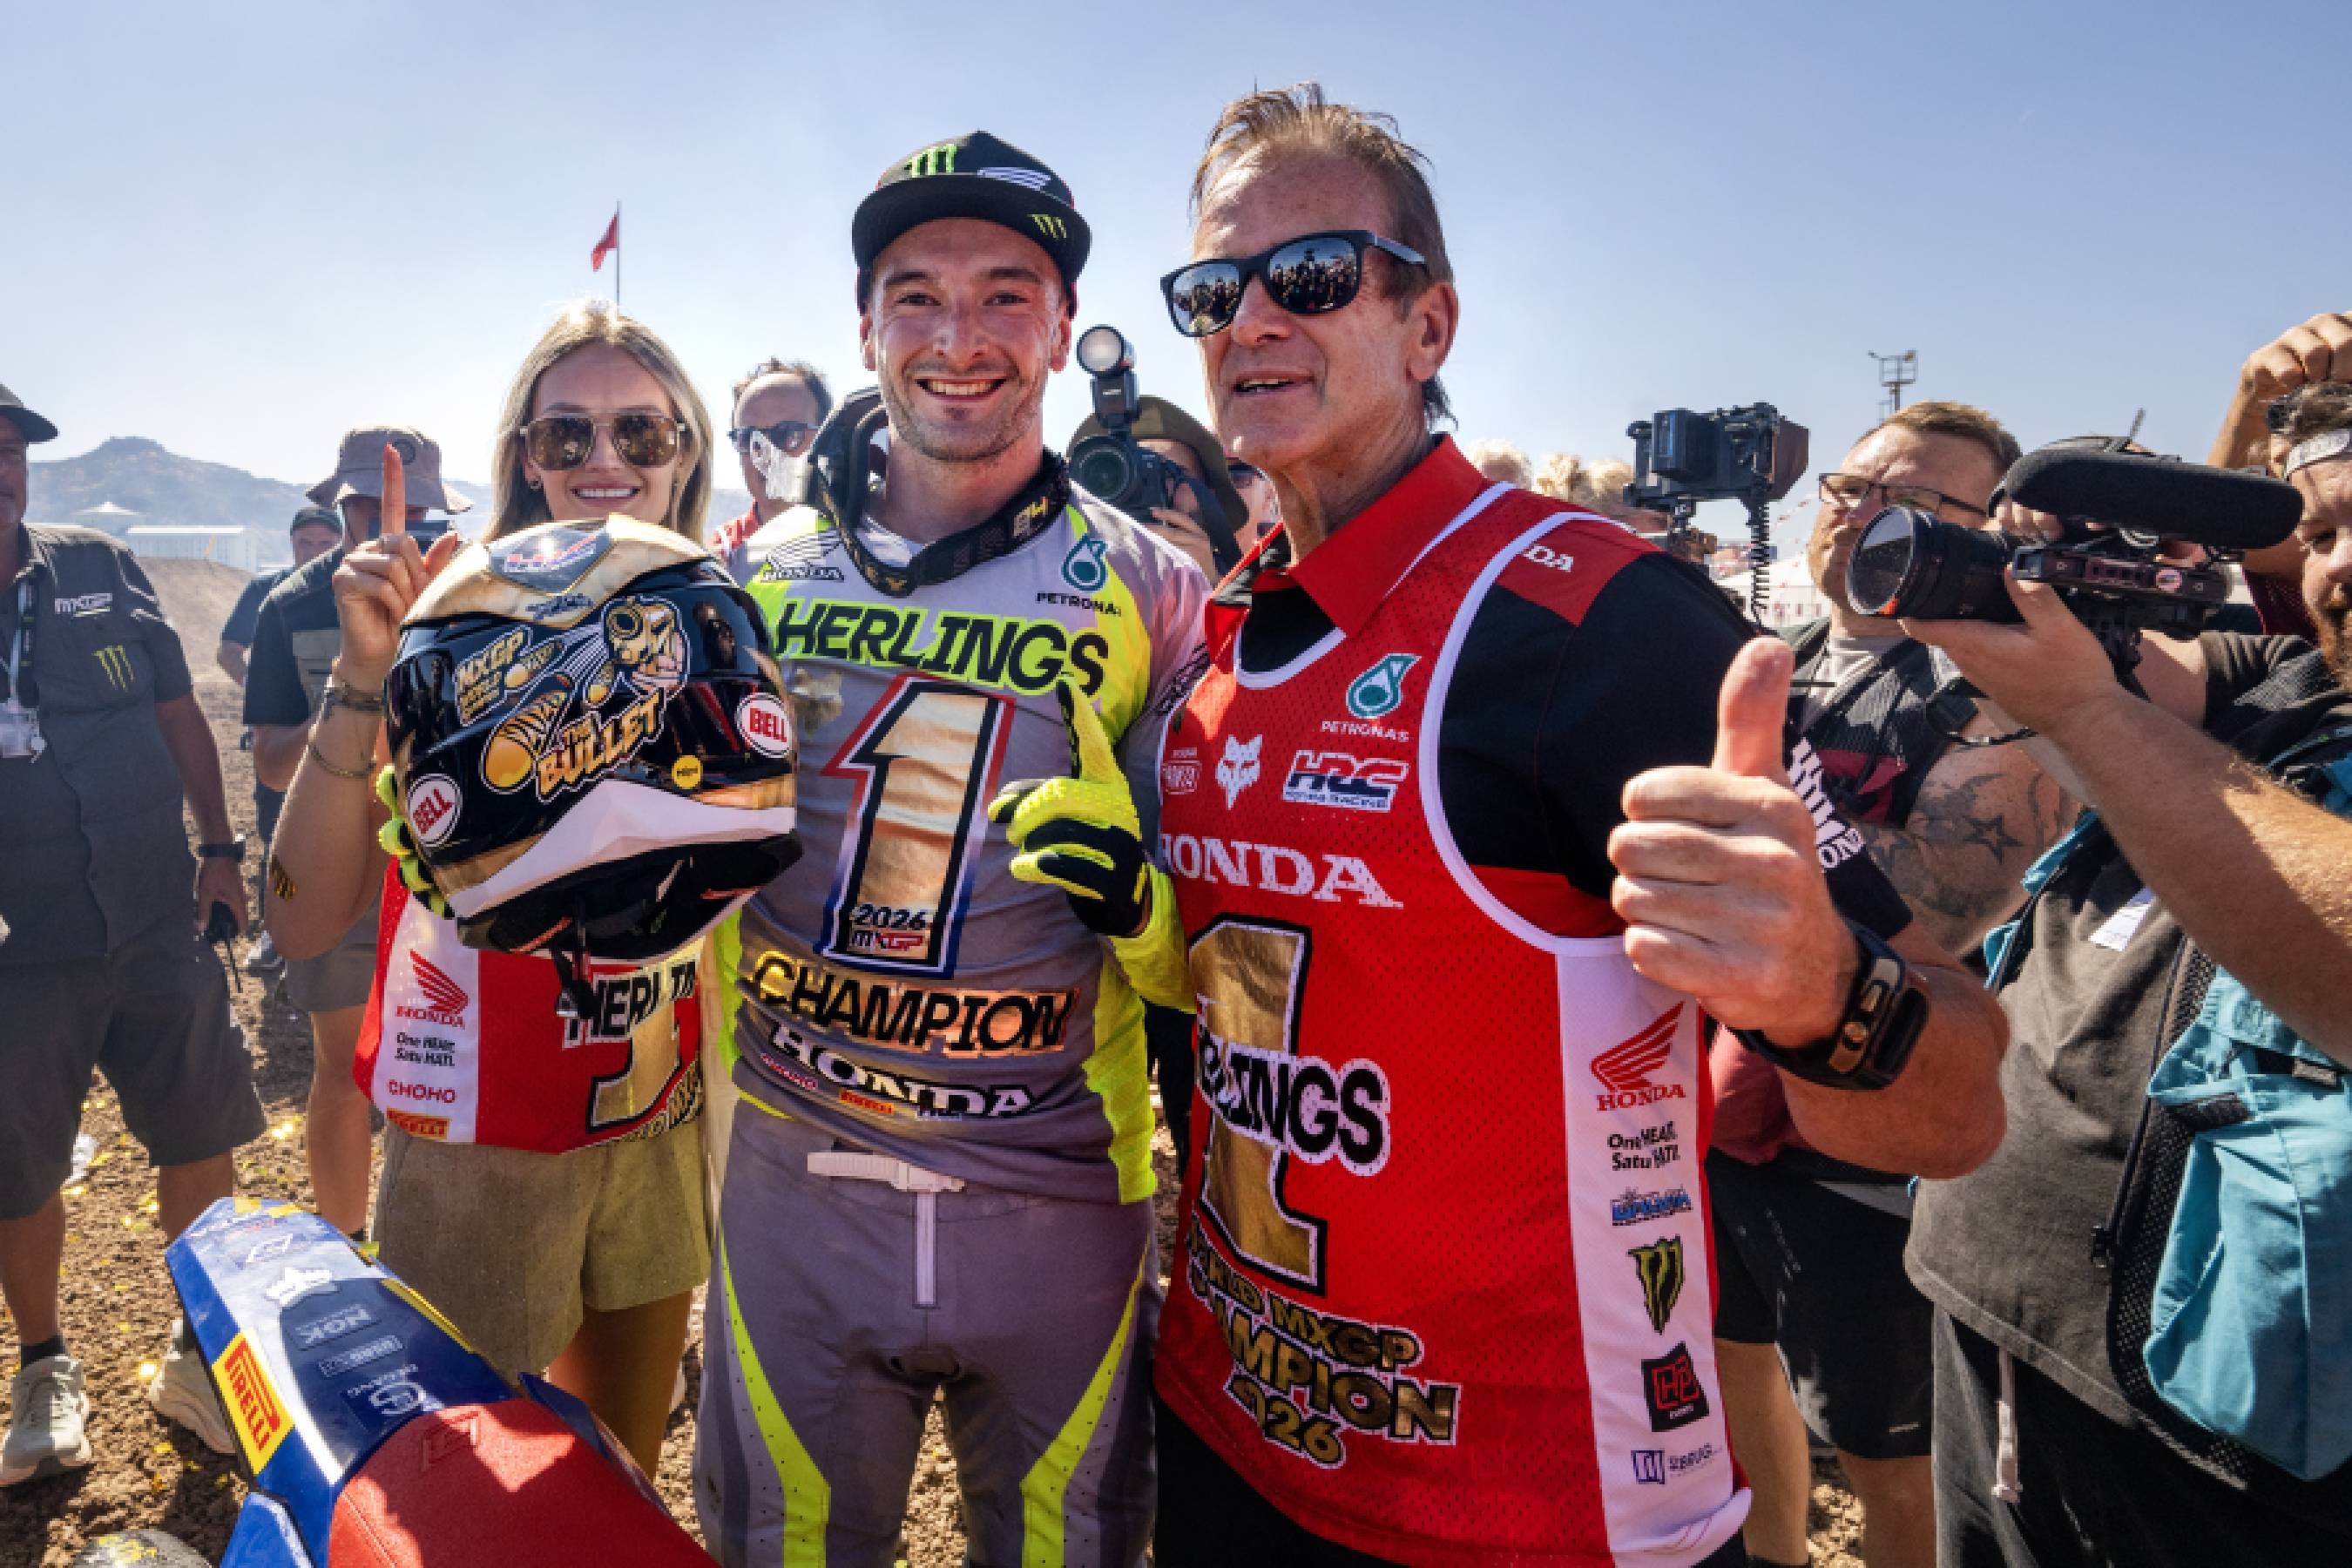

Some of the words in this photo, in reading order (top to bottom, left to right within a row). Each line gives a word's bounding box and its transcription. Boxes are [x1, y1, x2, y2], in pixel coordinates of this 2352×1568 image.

[778, 603, 1109, 697] HERLINGS
[537, 694, 660, 794] BULLET
[749, 706, 787, 743] BELL
[1321, 721, 1410, 743] PETRONAS
[1286, 750, 1410, 797] HRC
[413, 788, 453, 835] BELL
[815, 673, 1016, 978] 1
[853, 903, 928, 930] 2026
[851, 930, 925, 952] MXGP
[396, 1005, 466, 1030] HONDA
[752, 951, 1078, 1056] CHAMPION
[389, 1079, 456, 1104] CHOHO
[770, 1022, 1035, 1119] HONDA
[1597, 1084, 1686, 1111] HONDA
[1612, 1152, 1652, 1171] Satu
[299, 1308, 372, 1348] NGK
[1269, 1292, 1424, 1370] MXGP
[225, 1336, 281, 1451] PIRELLI
